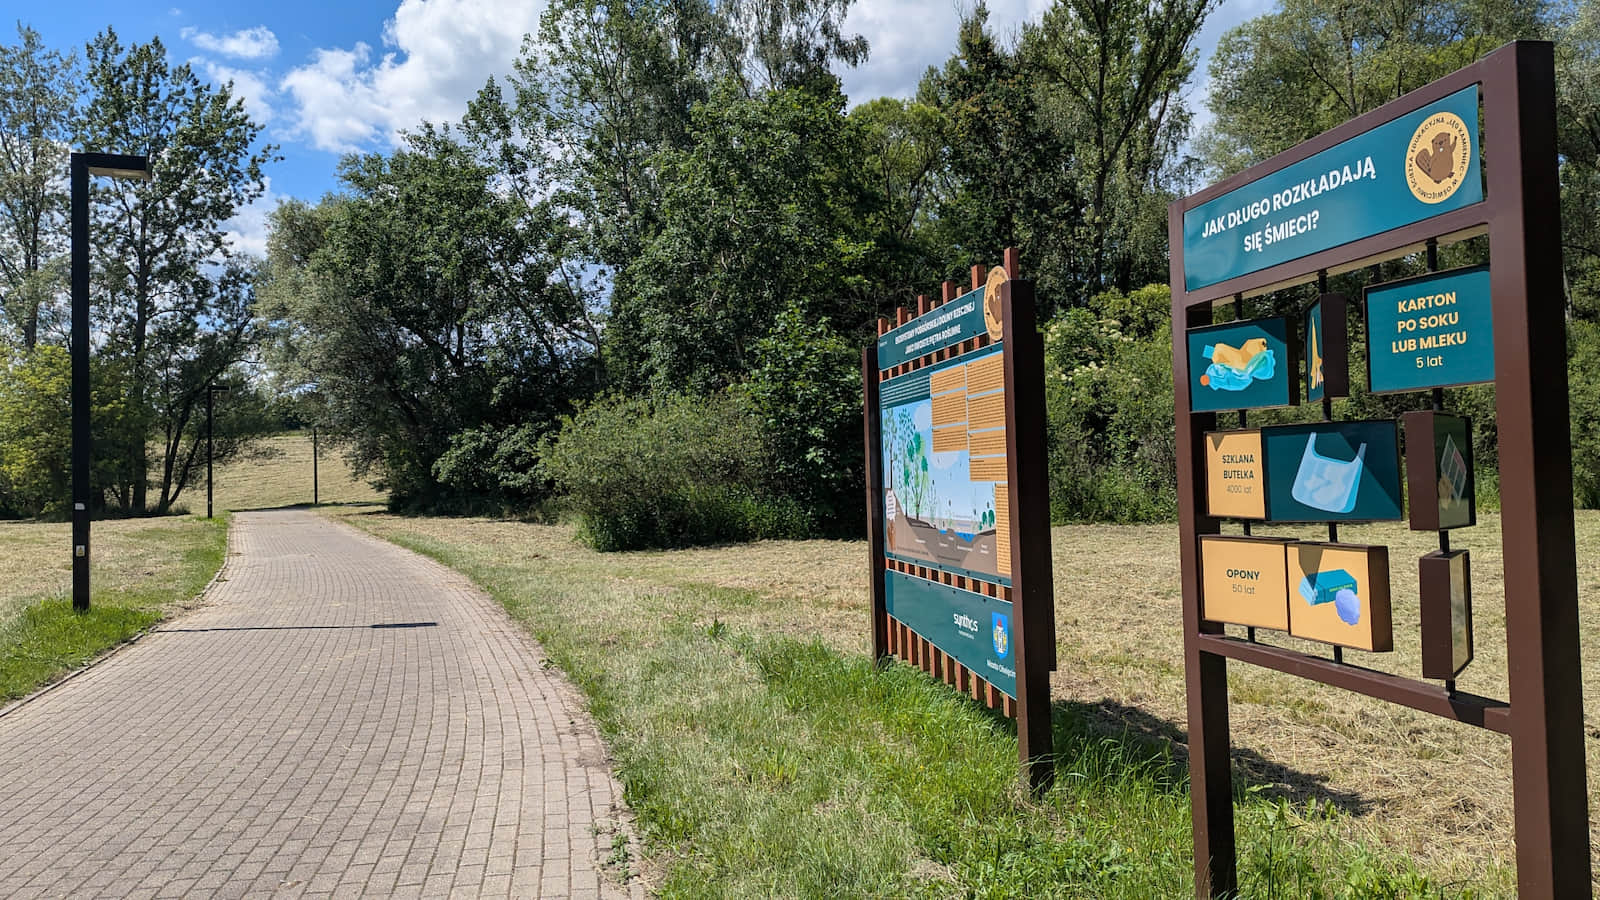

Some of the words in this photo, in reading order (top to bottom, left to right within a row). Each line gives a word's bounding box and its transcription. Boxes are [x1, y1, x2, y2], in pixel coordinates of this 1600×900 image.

[1202, 215, 1226, 238] JAK
[1228, 198, 1270, 229] DŁUGO
[1273, 156, 1376, 212] ROZKŁADAJĄ
[1244, 231, 1263, 252] SIĘ
[1264, 210, 1319, 245] ŚMIECI?
[1398, 292, 1456, 313] KARTON
[1398, 319, 1416, 333] PO
[1420, 312, 1458, 329] SOKU
[1392, 339, 1416, 353] LUB
[1420, 331, 1467, 349] MLEKU
[1416, 357, 1424, 368] 5
[1427, 355, 1443, 367] lat
[1222, 454, 1254, 464] SZKLANA
[1224, 470, 1254, 479] BUTELKA
[1226, 569, 1260, 580] OPONY
[1232, 584, 1242, 592] 50
[1244, 584, 1255, 594] lat
